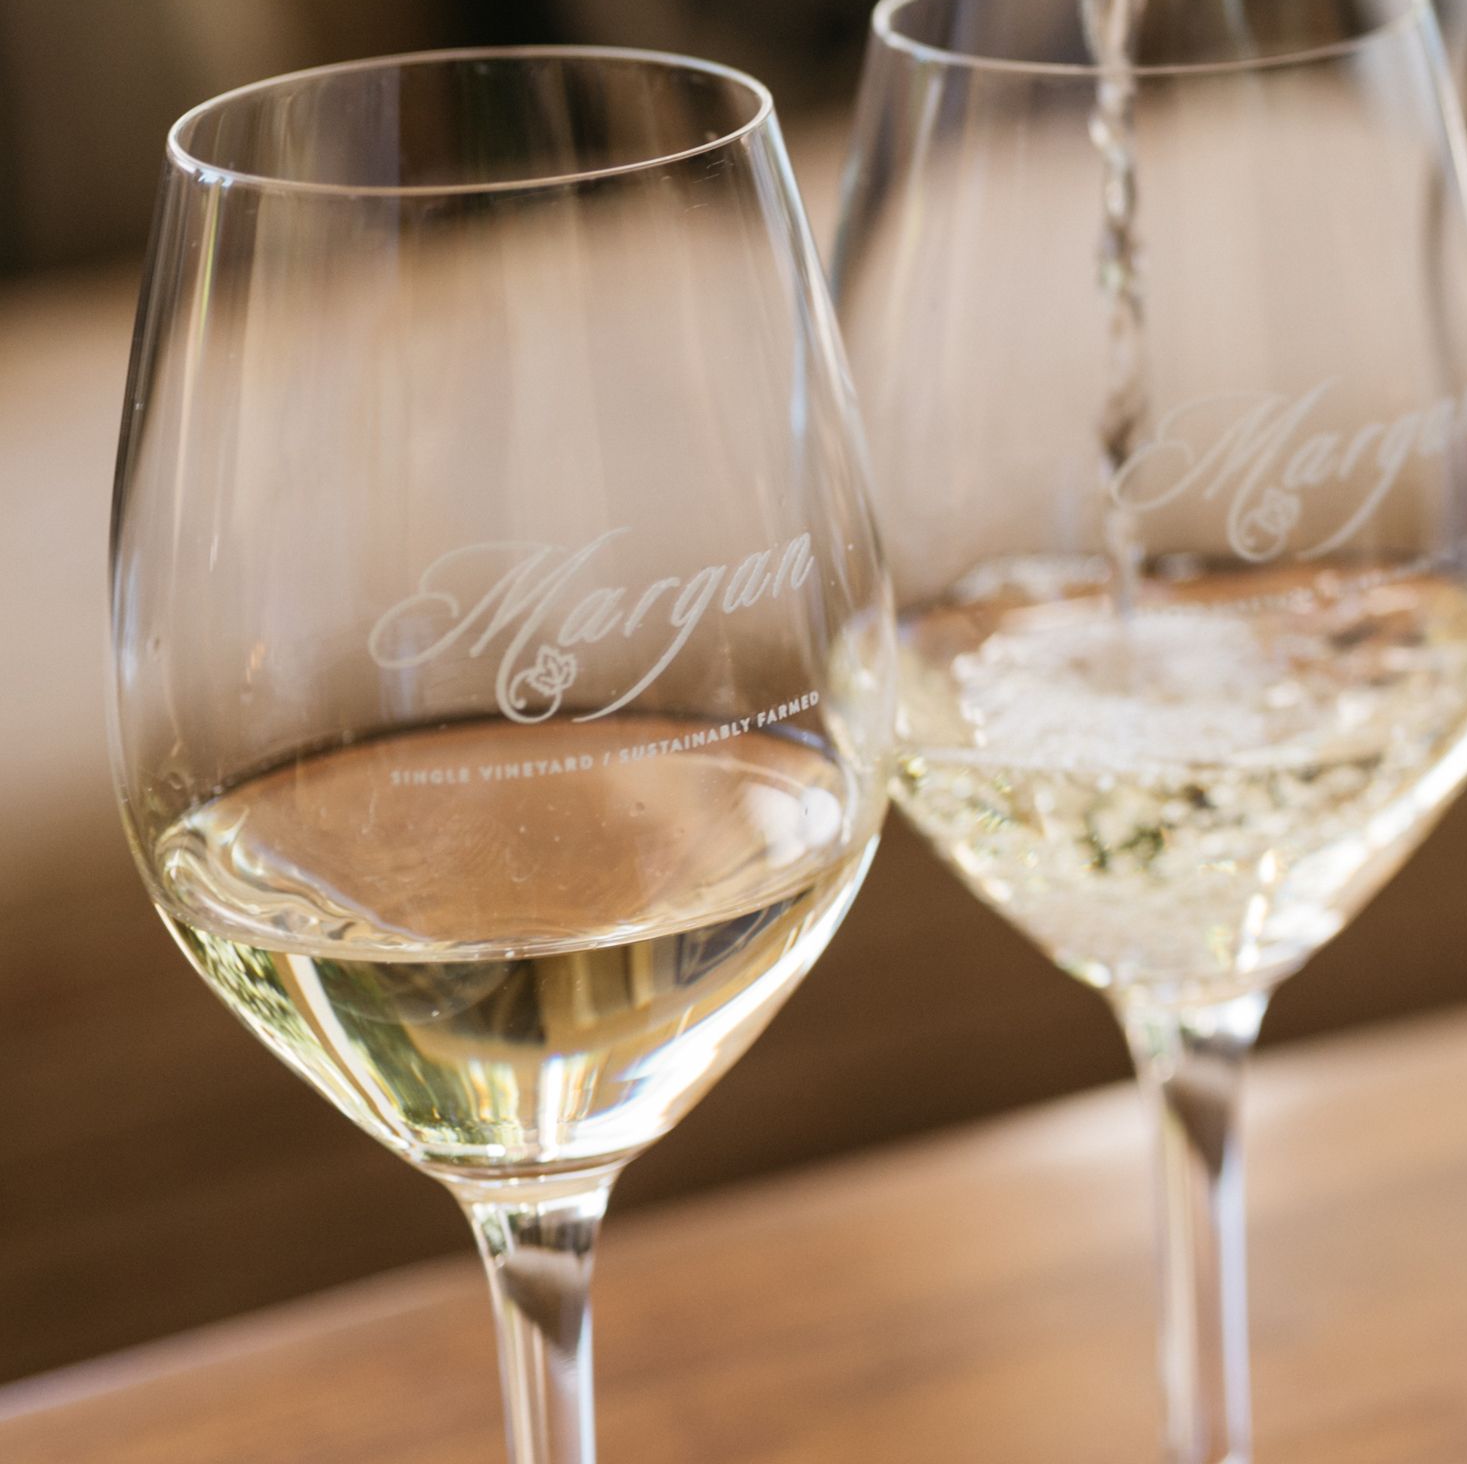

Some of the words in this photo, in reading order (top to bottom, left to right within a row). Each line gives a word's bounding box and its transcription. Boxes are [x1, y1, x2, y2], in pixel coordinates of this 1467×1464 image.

[369, 527, 815, 724] Margan
[388, 767, 473, 788] SINGLE
[478, 752, 595, 784] VINEYARD
[618, 716, 752, 765] SUSTAINABLY
[755, 690, 819, 728] FARMED
